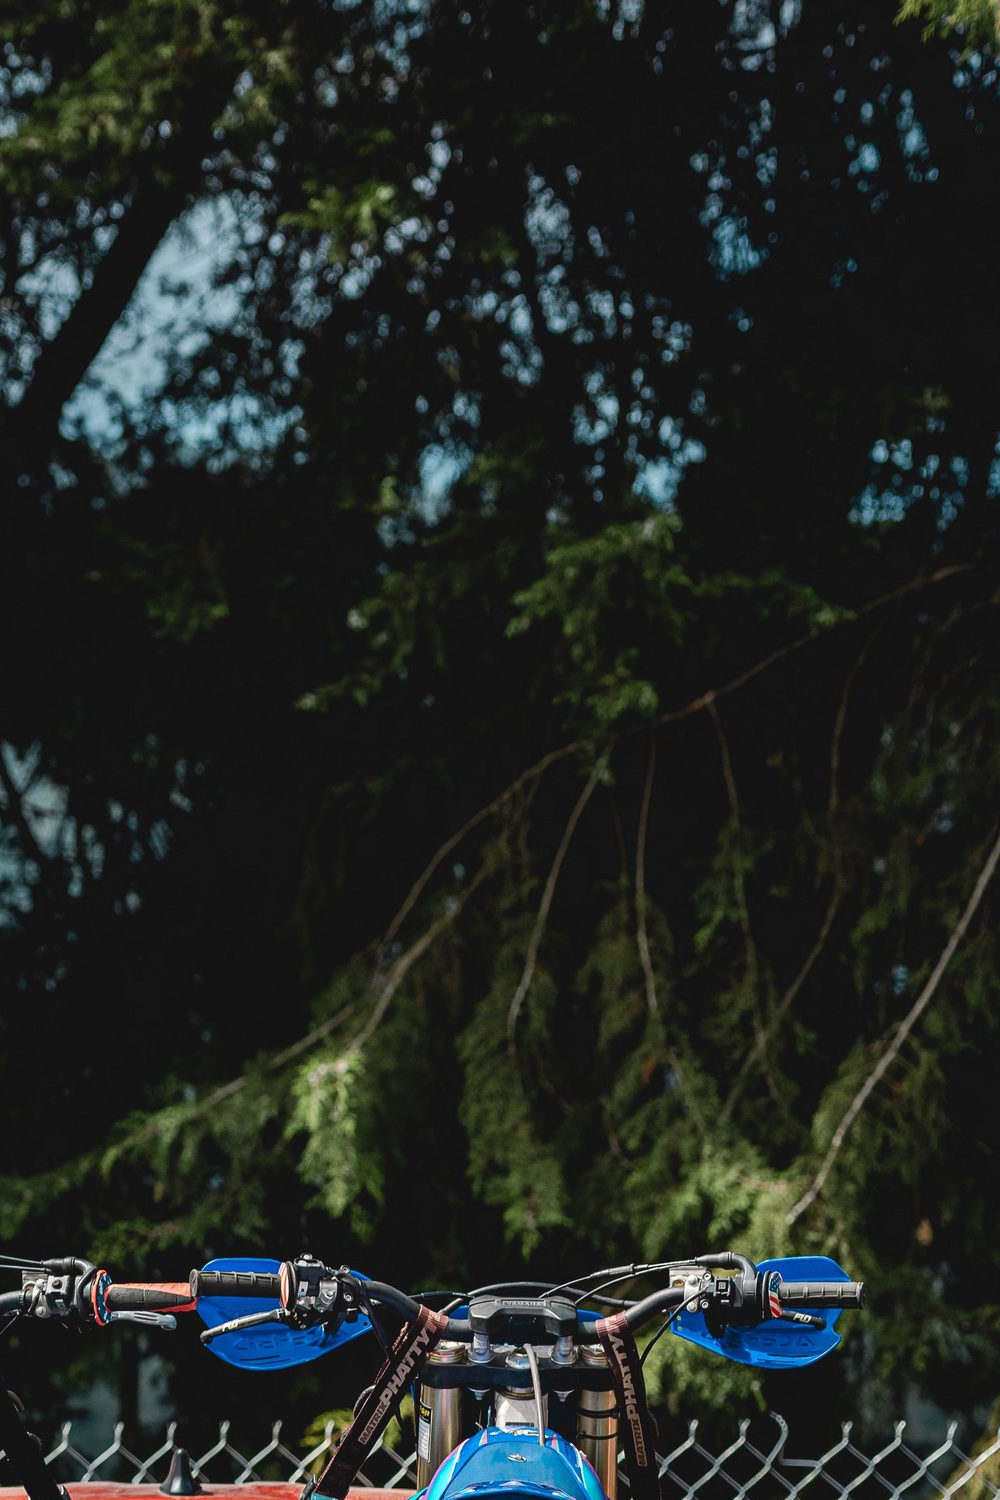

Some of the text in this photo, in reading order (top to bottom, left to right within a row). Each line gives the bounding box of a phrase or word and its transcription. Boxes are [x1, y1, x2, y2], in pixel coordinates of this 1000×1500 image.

[379, 1327, 431, 1403] PHATTY
[357, 1400, 391, 1446] MATRIX
[630, 1417, 649, 1467] MATRIX
